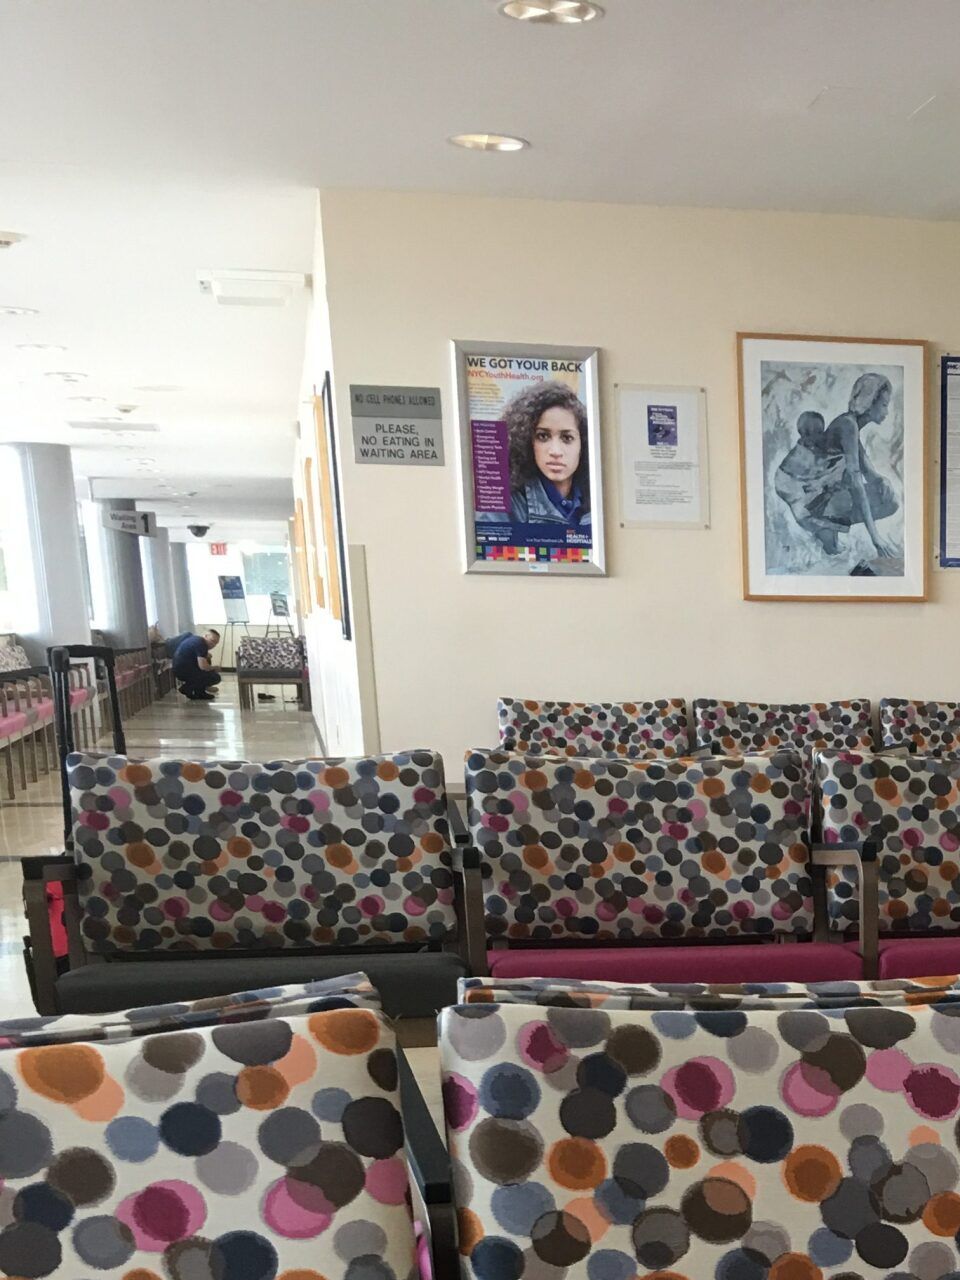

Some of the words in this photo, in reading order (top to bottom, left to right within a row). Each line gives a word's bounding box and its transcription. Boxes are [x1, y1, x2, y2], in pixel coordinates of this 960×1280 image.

[467, 358, 486, 368] WE
[489, 358, 513, 369] GOT
[515, 359, 549, 371] YOUR
[551, 361, 583, 373] BACK
[467, 370, 544, 382] NYCYouthHealth.org
[375, 423, 419, 435] PLEASE,
[361, 435, 377, 446] NO
[382, 436, 420, 447] EATING
[424, 437, 434, 447] IN
[360, 448, 405, 459] WAITING
[410, 449, 438, 460] AREA
[141, 513, 149, 533] 1
